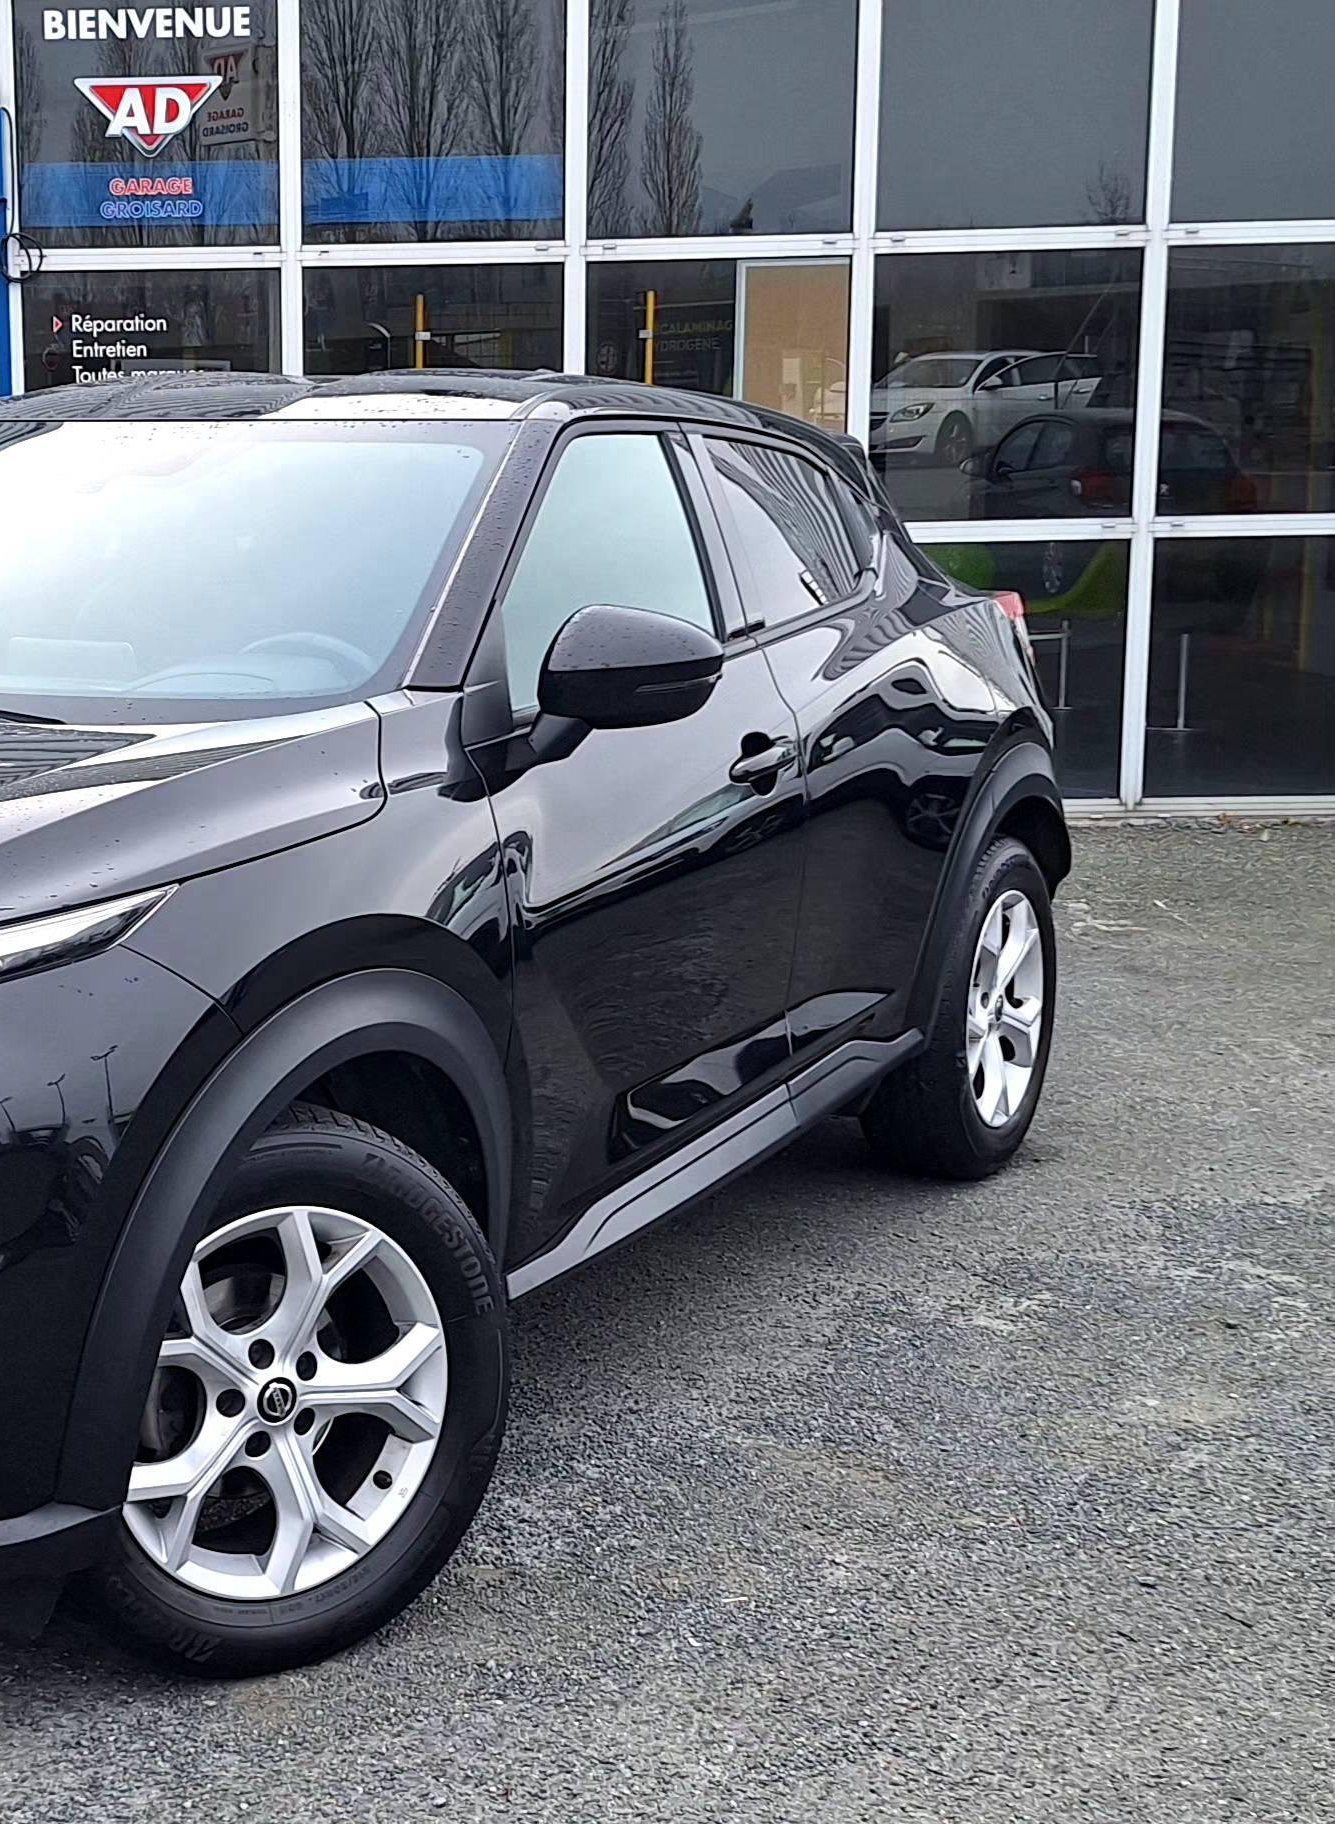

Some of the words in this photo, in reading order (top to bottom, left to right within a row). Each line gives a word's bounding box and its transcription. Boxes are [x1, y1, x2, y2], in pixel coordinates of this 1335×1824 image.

[43, 6, 251, 41] BIENVENUE
[104, 86, 193, 138] AD
[109, 176, 194, 196] GARAGE
[99, 199, 204, 220] GROISARD
[71, 313, 167, 338] Réparation
[658, 319, 733, 335] CALAMINAG
[72, 339, 147, 358] Entretien
